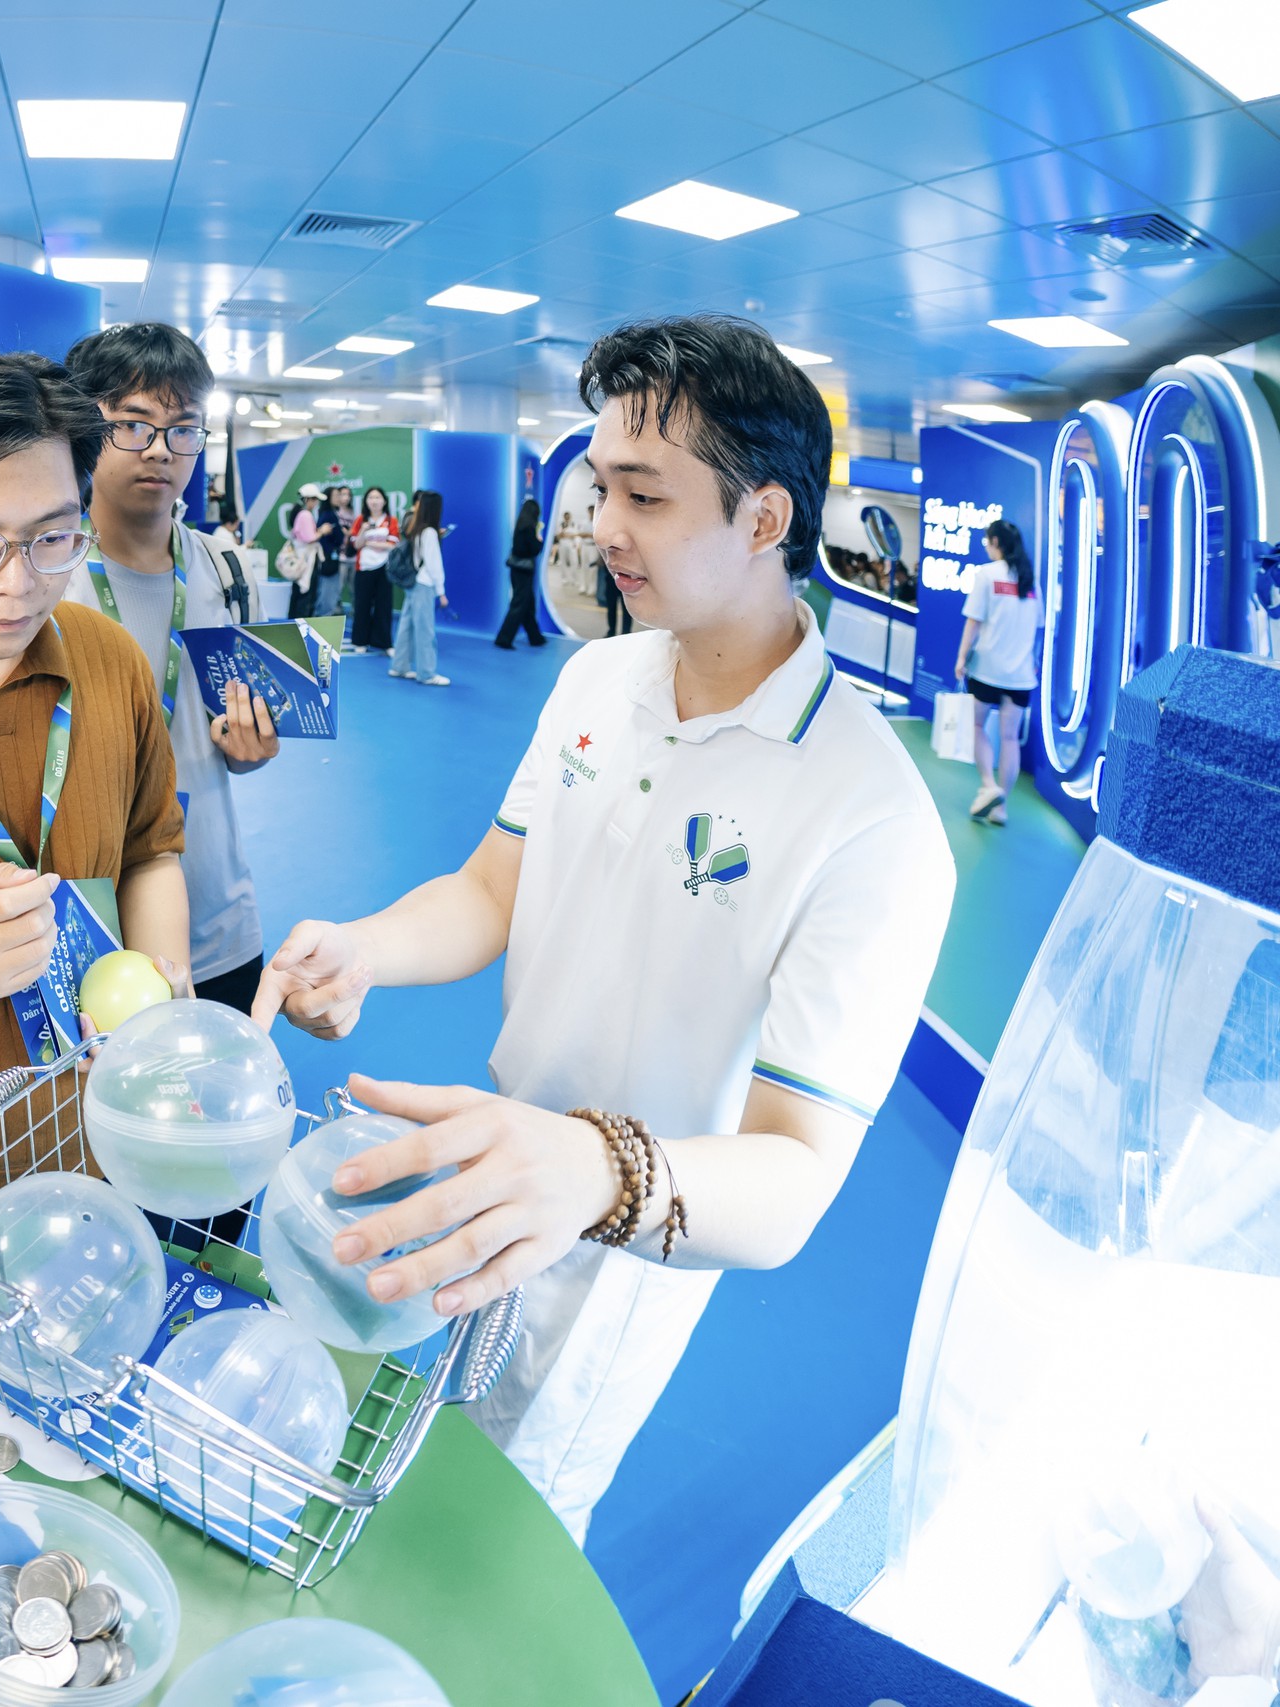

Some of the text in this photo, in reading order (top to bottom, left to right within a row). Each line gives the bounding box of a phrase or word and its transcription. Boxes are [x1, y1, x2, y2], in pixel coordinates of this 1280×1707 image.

[559, 745, 597, 781] Heineken
[22, 1009, 40, 1022] Dân
[161, 1282, 181, 1303] COURT
